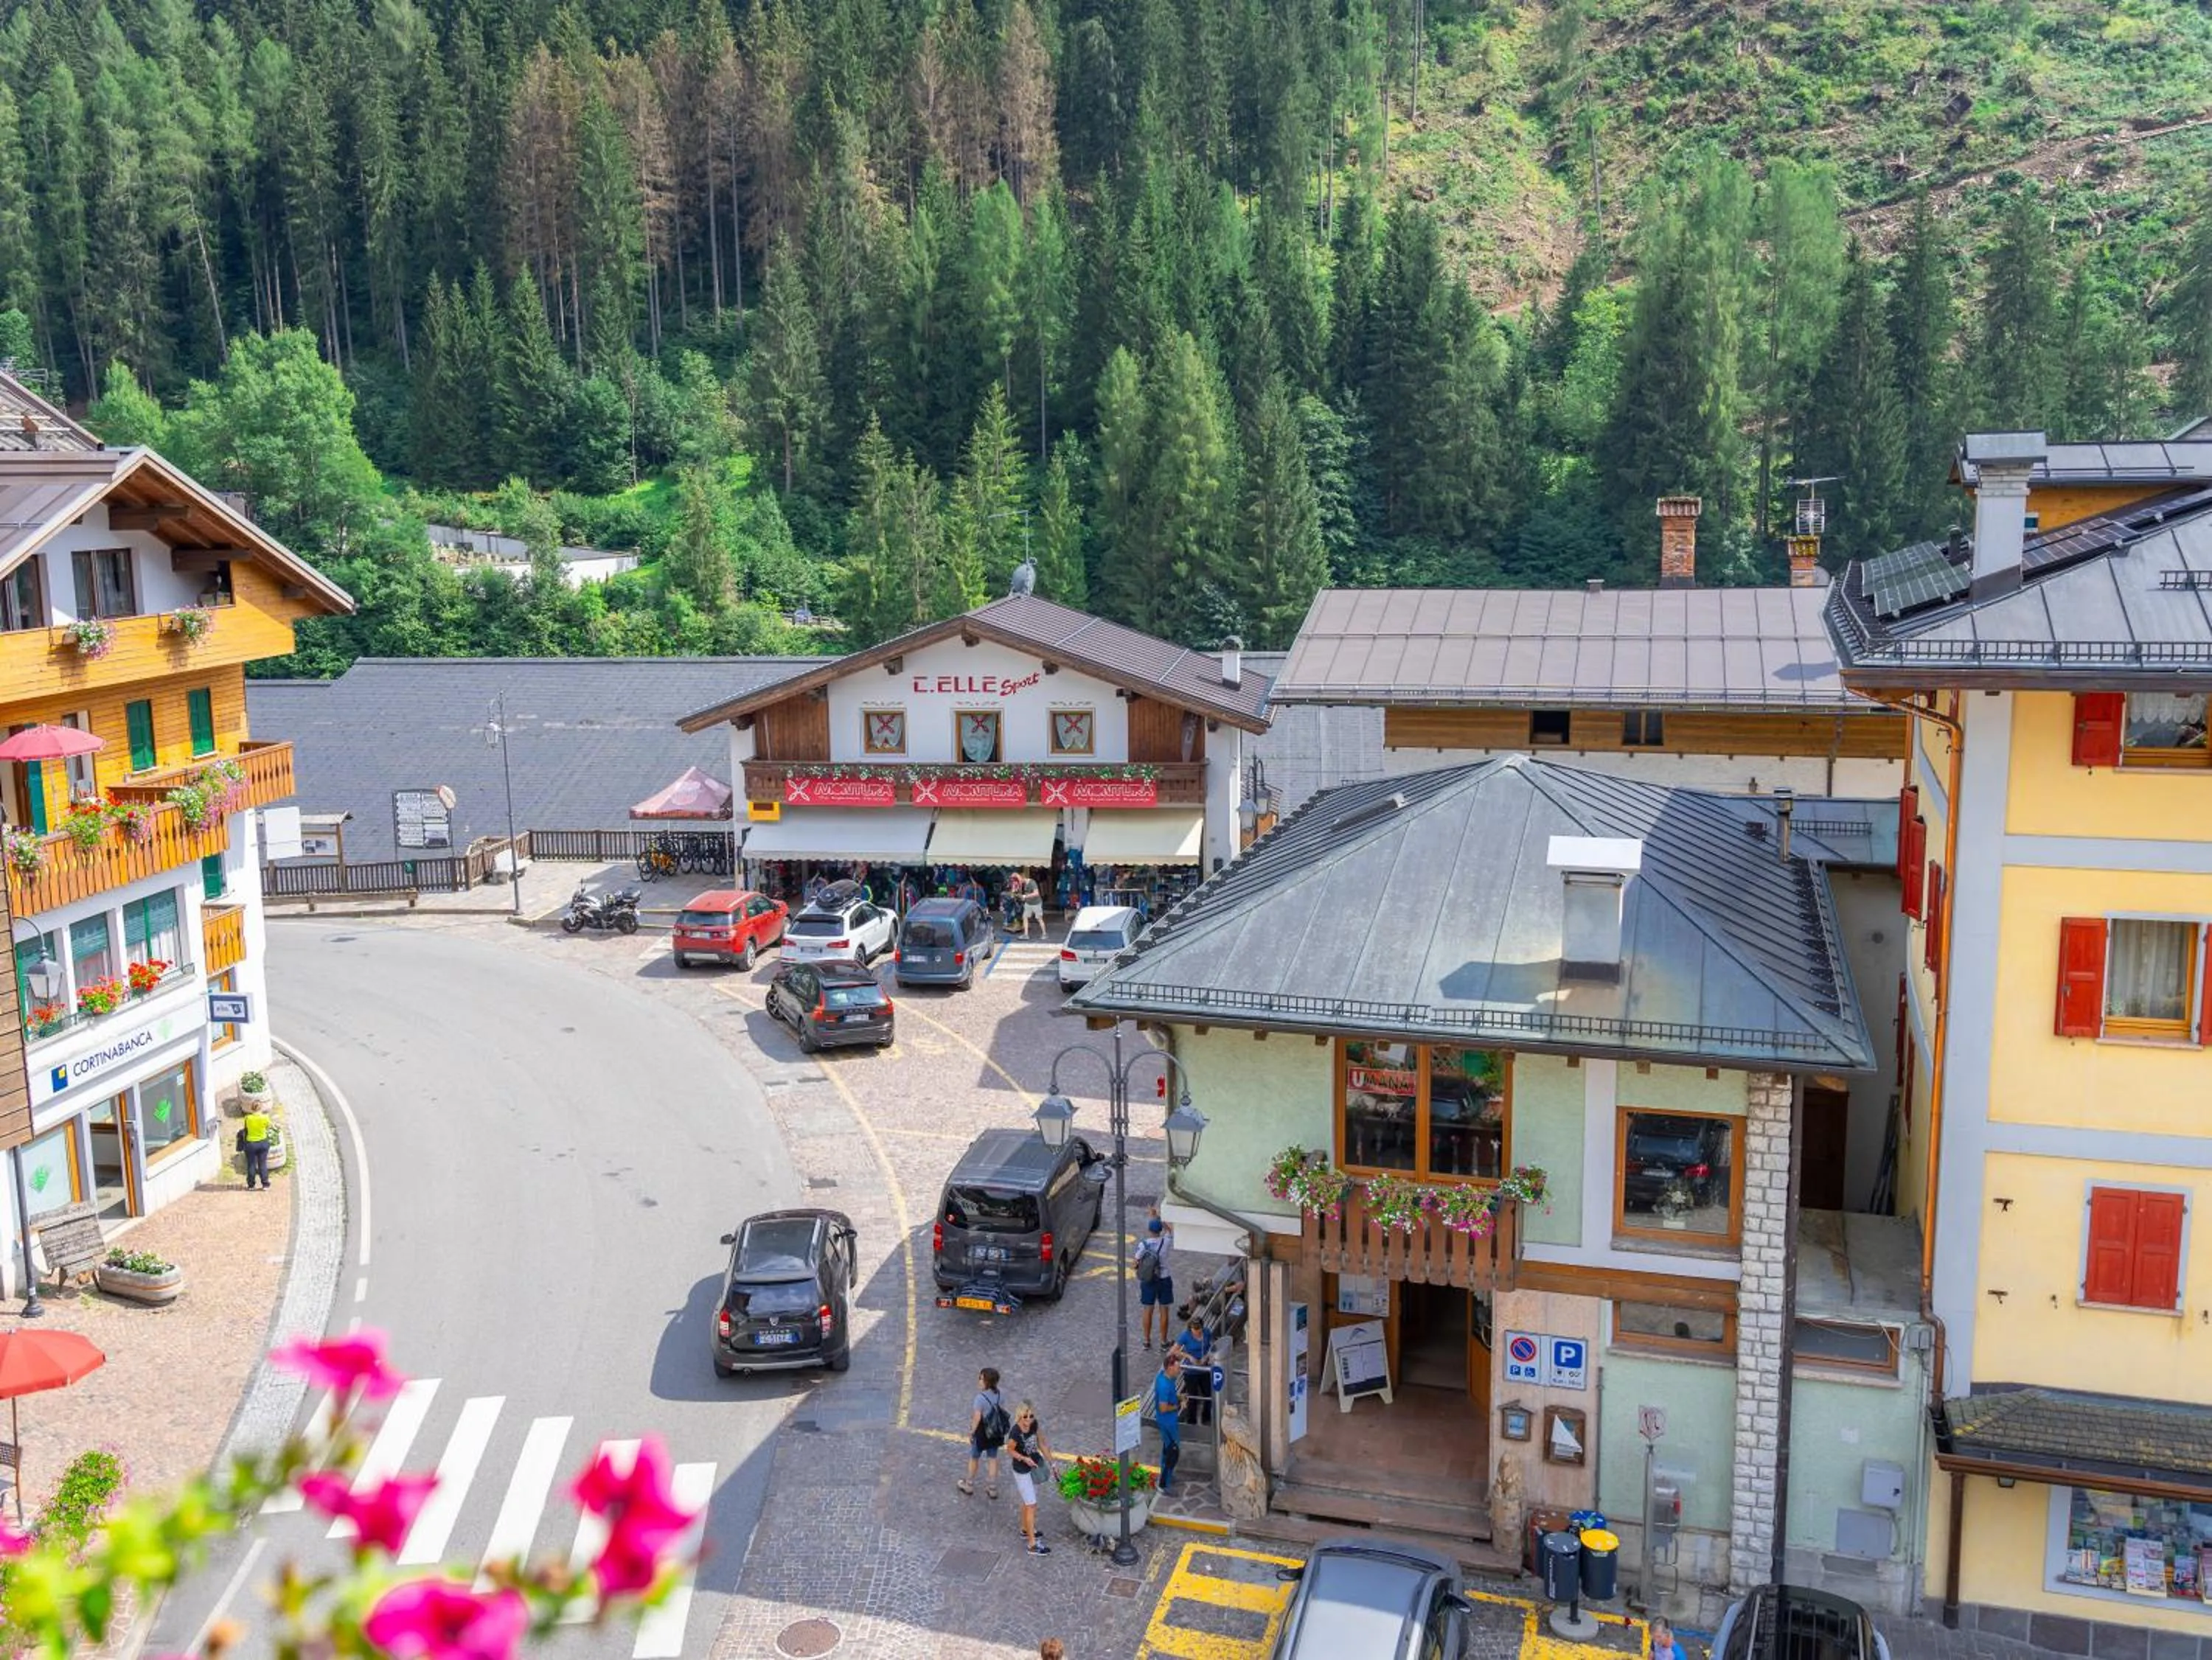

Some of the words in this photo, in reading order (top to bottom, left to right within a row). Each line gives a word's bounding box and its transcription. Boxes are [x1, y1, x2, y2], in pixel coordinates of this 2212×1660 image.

[1000, 672, 1040, 697] Sport
[73, 1030, 153, 1077] CORTINABANCA
[1559, 1345, 1576, 1363] P
[1213, 1372, 1222, 1385] P
